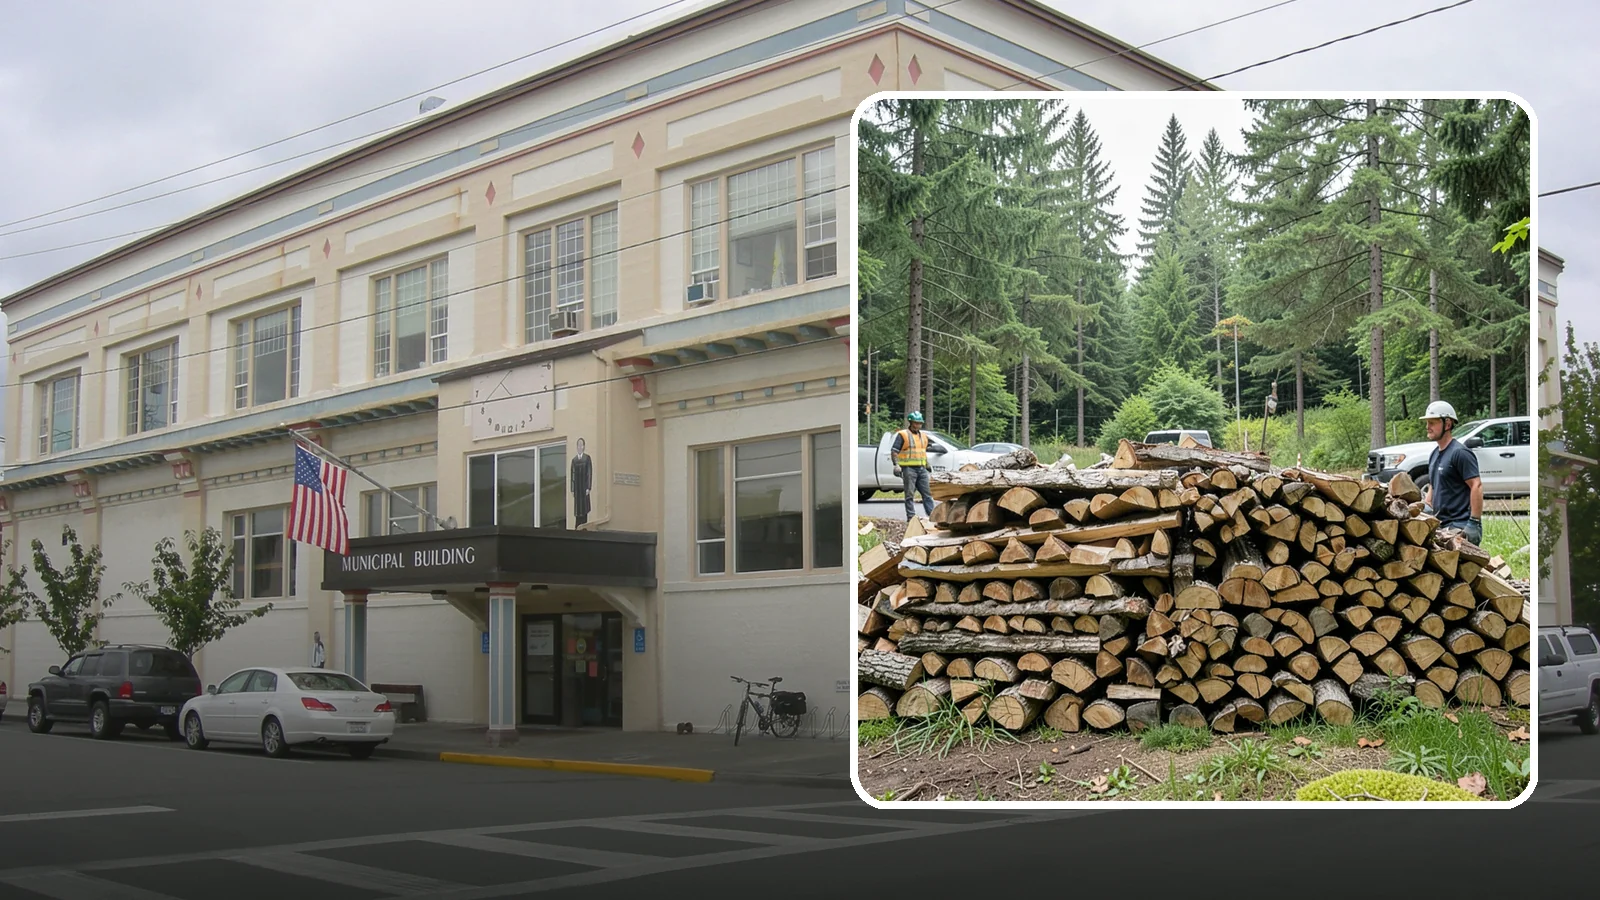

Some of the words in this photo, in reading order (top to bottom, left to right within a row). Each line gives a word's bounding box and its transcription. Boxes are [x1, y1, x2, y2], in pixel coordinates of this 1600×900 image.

[481, 407, 485, 415] 8
[529, 414, 533, 422] 3
[494, 424, 500, 432] 10
[342, 552, 405, 572] MUNICIPAL
[414, 546, 475, 567] BUILDING
